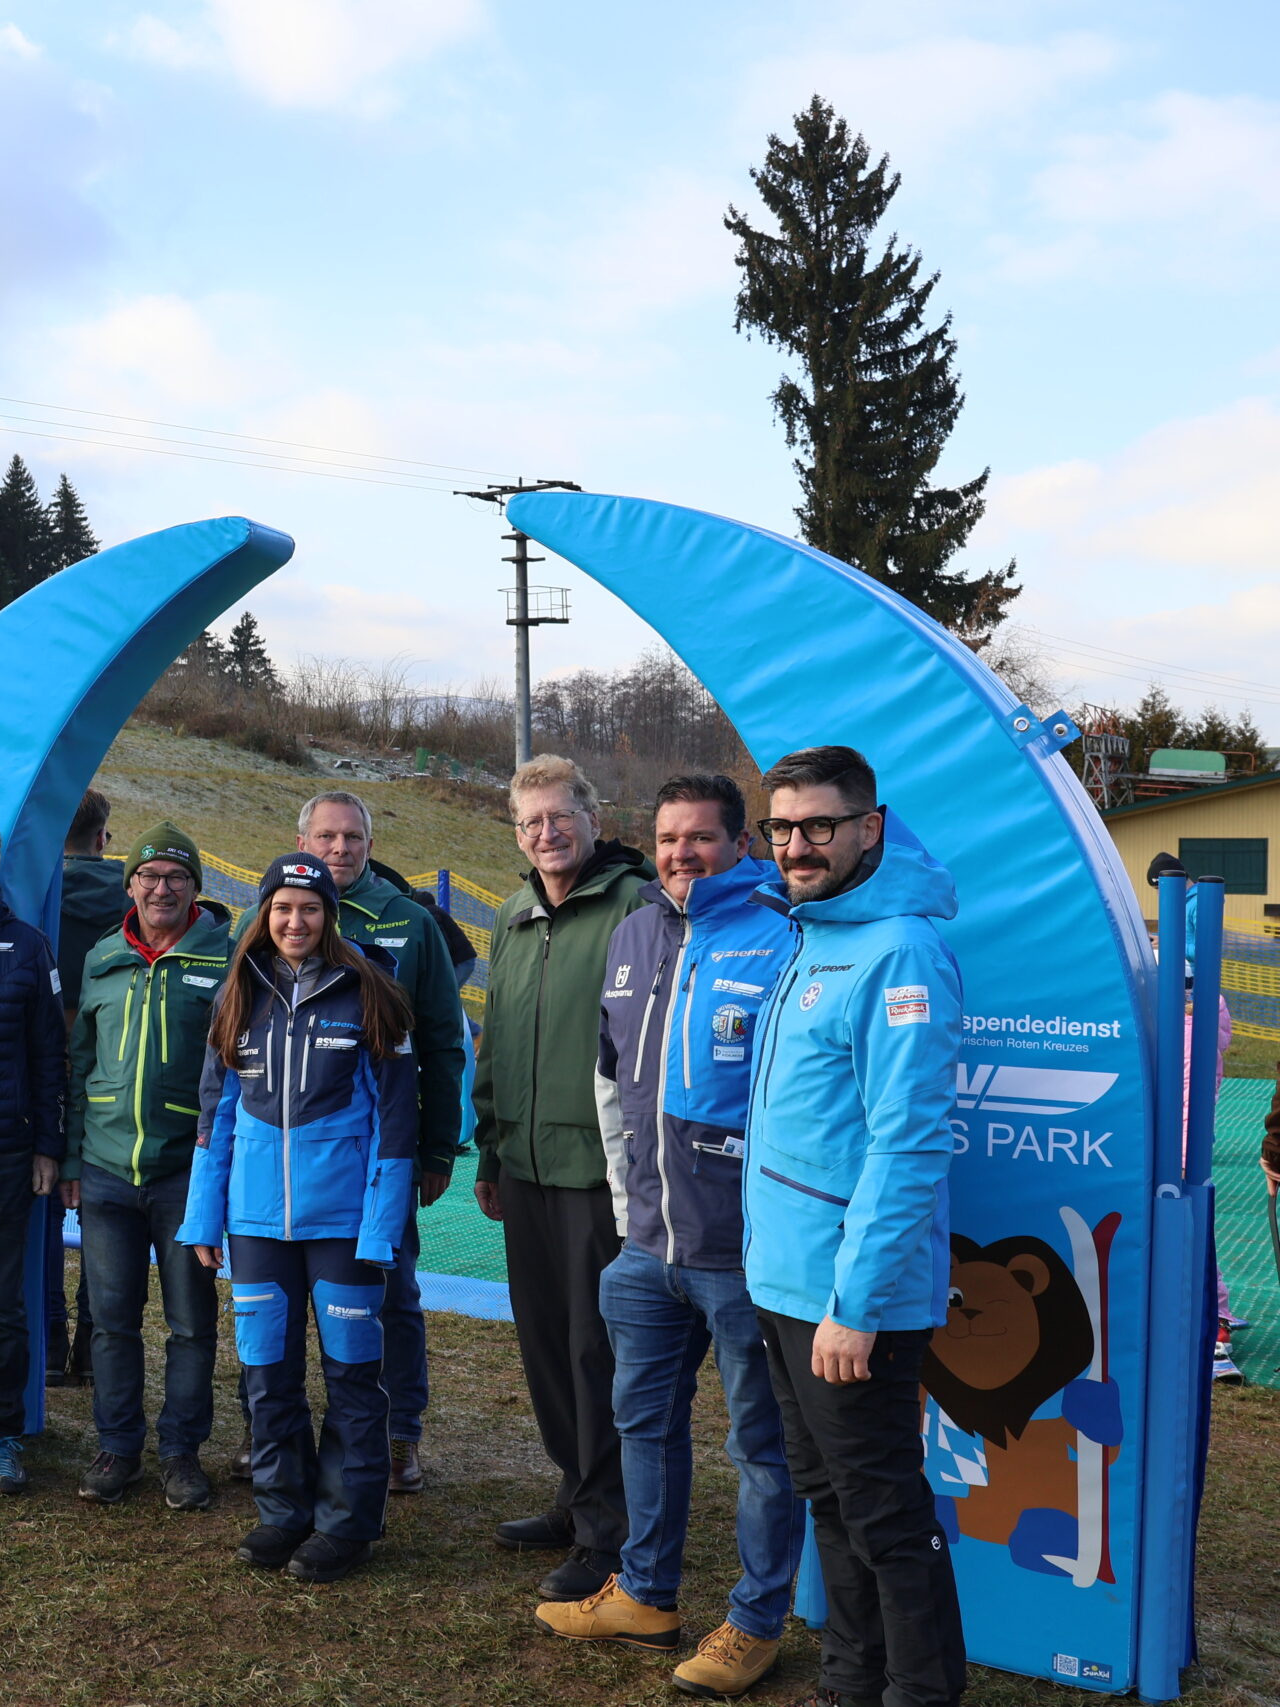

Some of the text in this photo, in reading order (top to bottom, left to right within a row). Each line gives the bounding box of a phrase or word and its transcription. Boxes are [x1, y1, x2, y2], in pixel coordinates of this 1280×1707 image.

[282, 864, 322, 879] WOLF
[377, 919, 410, 930] ziener
[723, 949, 774, 958] ziener
[818, 963, 856, 973] ziener
[713, 978, 738, 990] BSV
[605, 988, 635, 999] Husqvarna
[315, 1037, 337, 1048] BSV
[1006, 1037, 1040, 1050] Roten
[1043, 1039, 1090, 1053] Kreuzes
[986, 1122, 1114, 1168] PARK
[327, 1303, 350, 1315] BSV
